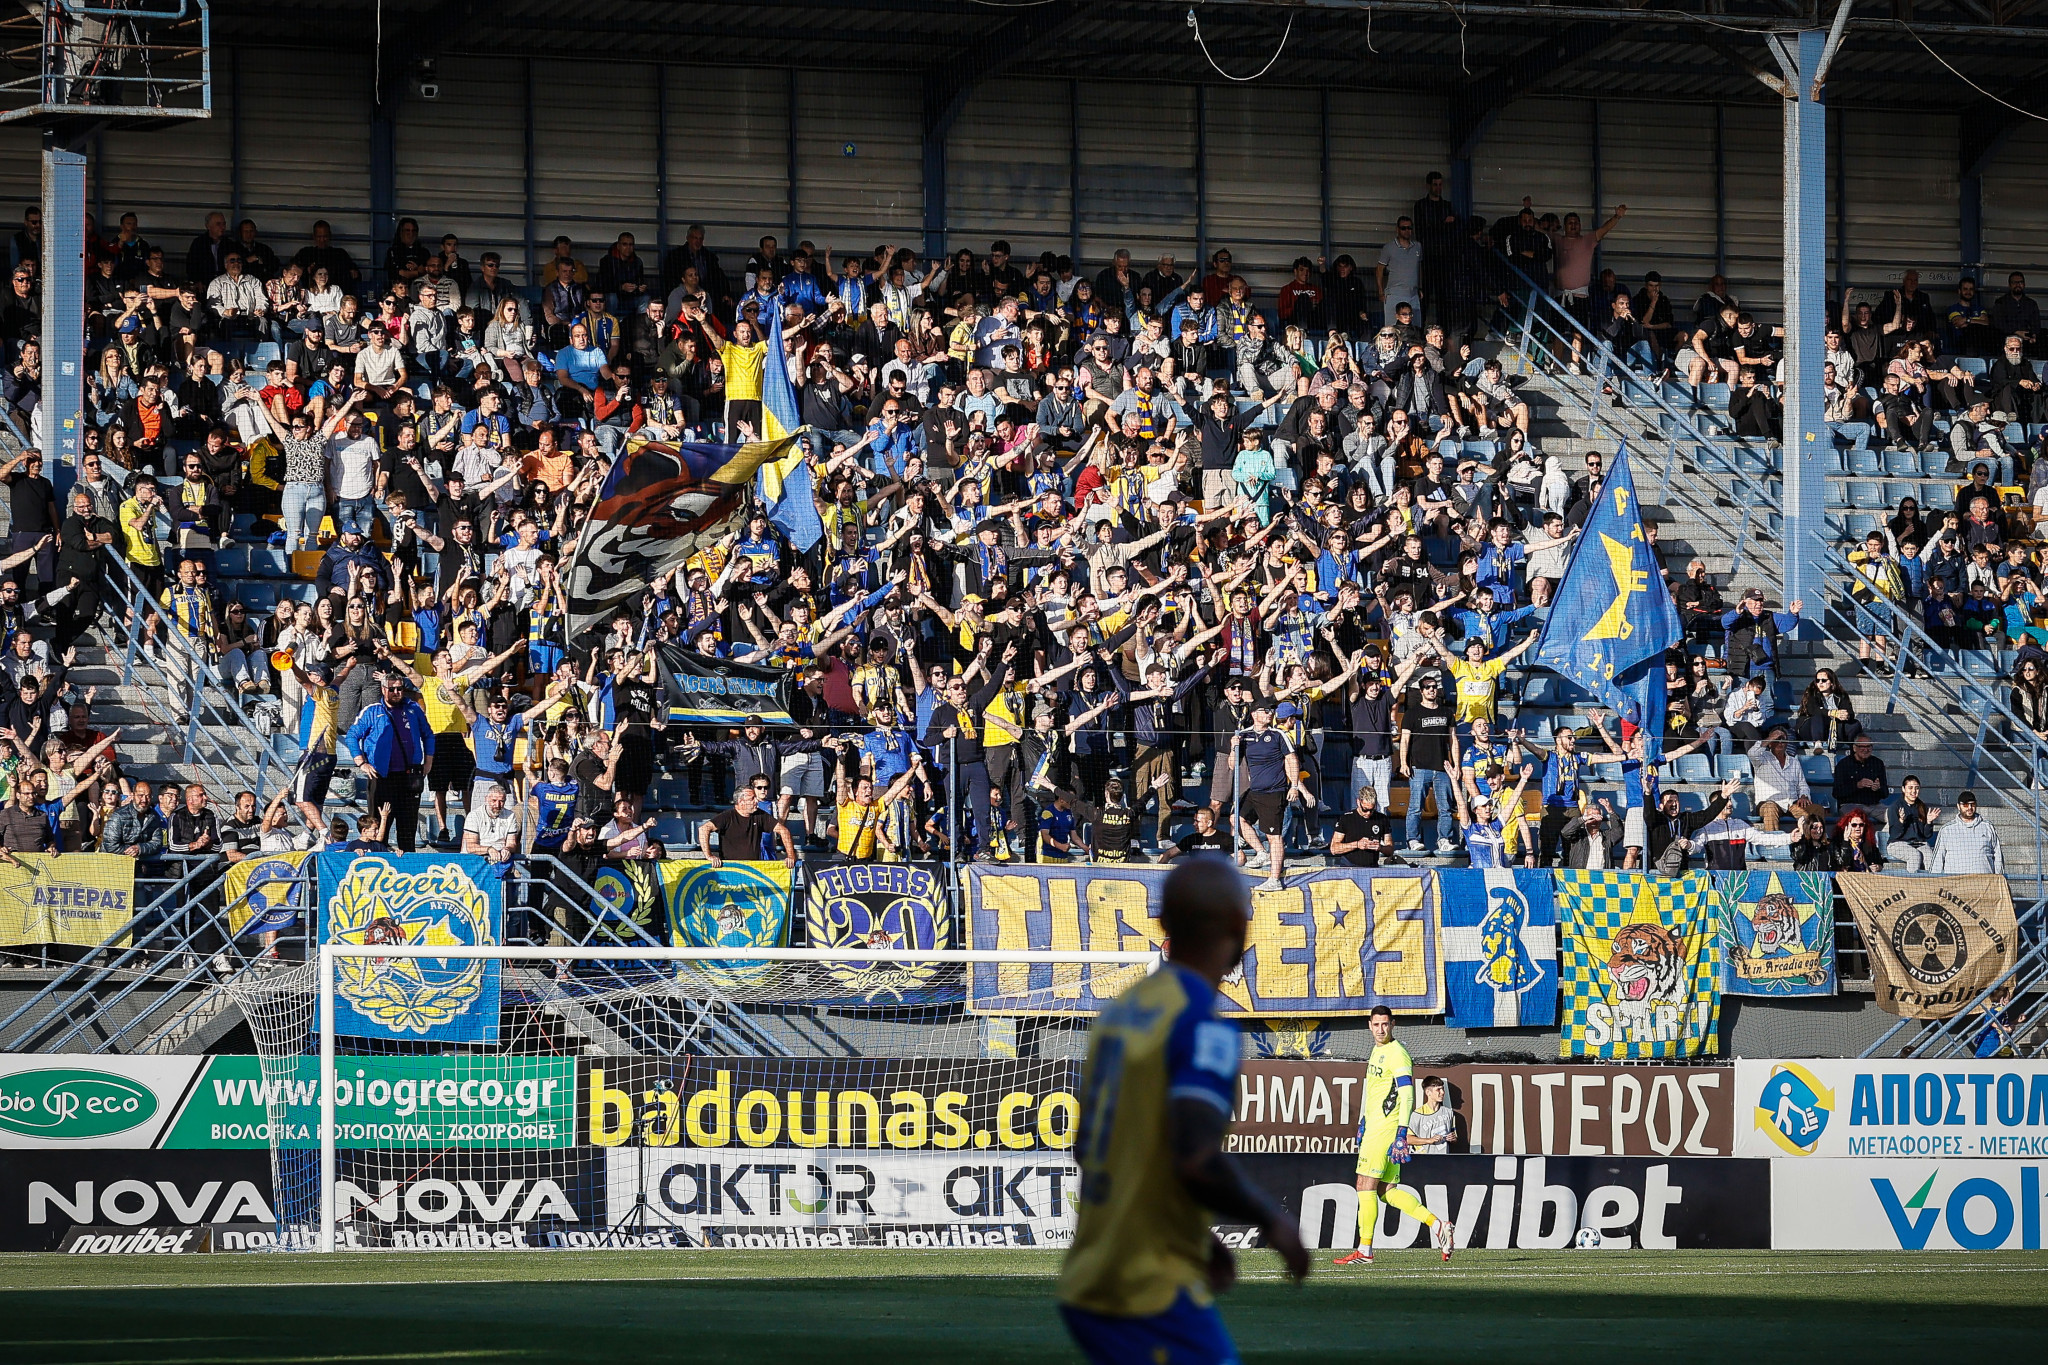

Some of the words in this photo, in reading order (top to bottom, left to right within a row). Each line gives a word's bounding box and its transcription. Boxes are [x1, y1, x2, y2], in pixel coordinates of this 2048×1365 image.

[1416, 568, 1428, 578] 94
[673, 673, 727, 695] TIGERS
[555, 803, 568, 828] 7
[353, 859, 467, 906] Tigers
[815, 864, 932, 899] TIGERS
[32, 886, 128, 910] ΑΣΤΕΡΑΣ
[251, 902, 290, 921] FOTBALL
[825, 898, 937, 972] 20
[1766, 959, 1803, 973] Arcadia
[1909, 966, 1960, 984] ΠΥΡΗΝΑΣ
[857, 970, 911, 991] years
[589, 1068, 1079, 1149] badounas.co
[1470, 1072, 1720, 1156] ΠΙΤΕΡΟΣ
[448, 1123, 557, 1140] ΖΩΟΤΡΟΦΕΣ
[1849, 1135, 1963, 1155] ΜΕΤΑΦΟΡΕΣ
[29, 1180, 276, 1225] NOVA
[335, 1178, 580, 1223] NOVA
[1300, 1157, 1683, 1248] novibet
[1870, 1166, 2048, 1250] vol
[68, 1227, 194, 1253] novibet
[393, 1223, 526, 1248] novibet
[722, 1226, 856, 1248] novibet
[885, 1225, 1021, 1248] novibet
